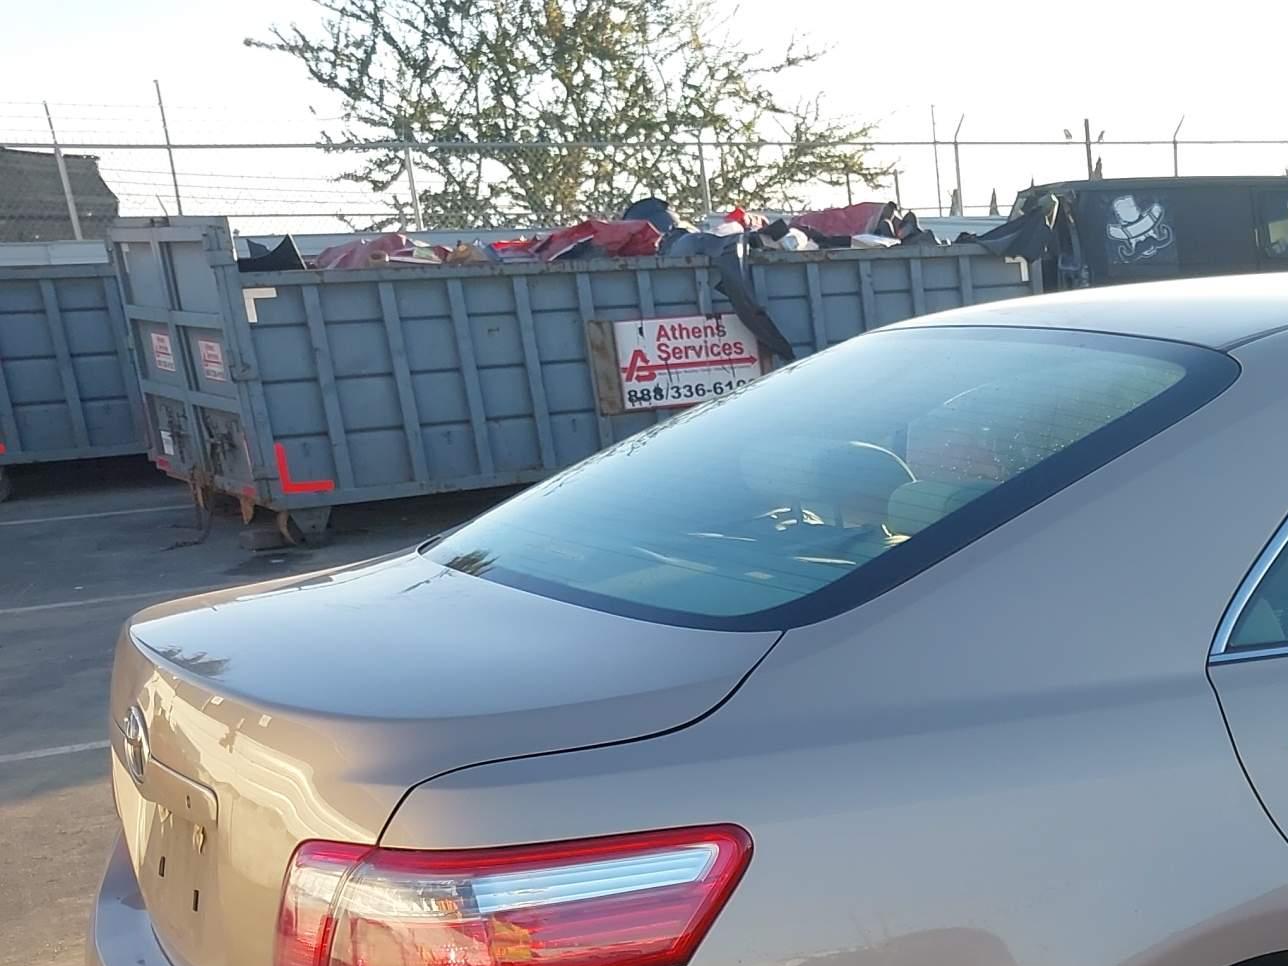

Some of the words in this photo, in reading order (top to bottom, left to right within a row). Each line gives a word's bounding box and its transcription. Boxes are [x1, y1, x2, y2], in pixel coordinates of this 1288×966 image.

[656, 322, 727, 343] Athens
[657, 339, 745, 363] Services
[627, 378, 755, 403] 888/336-61
